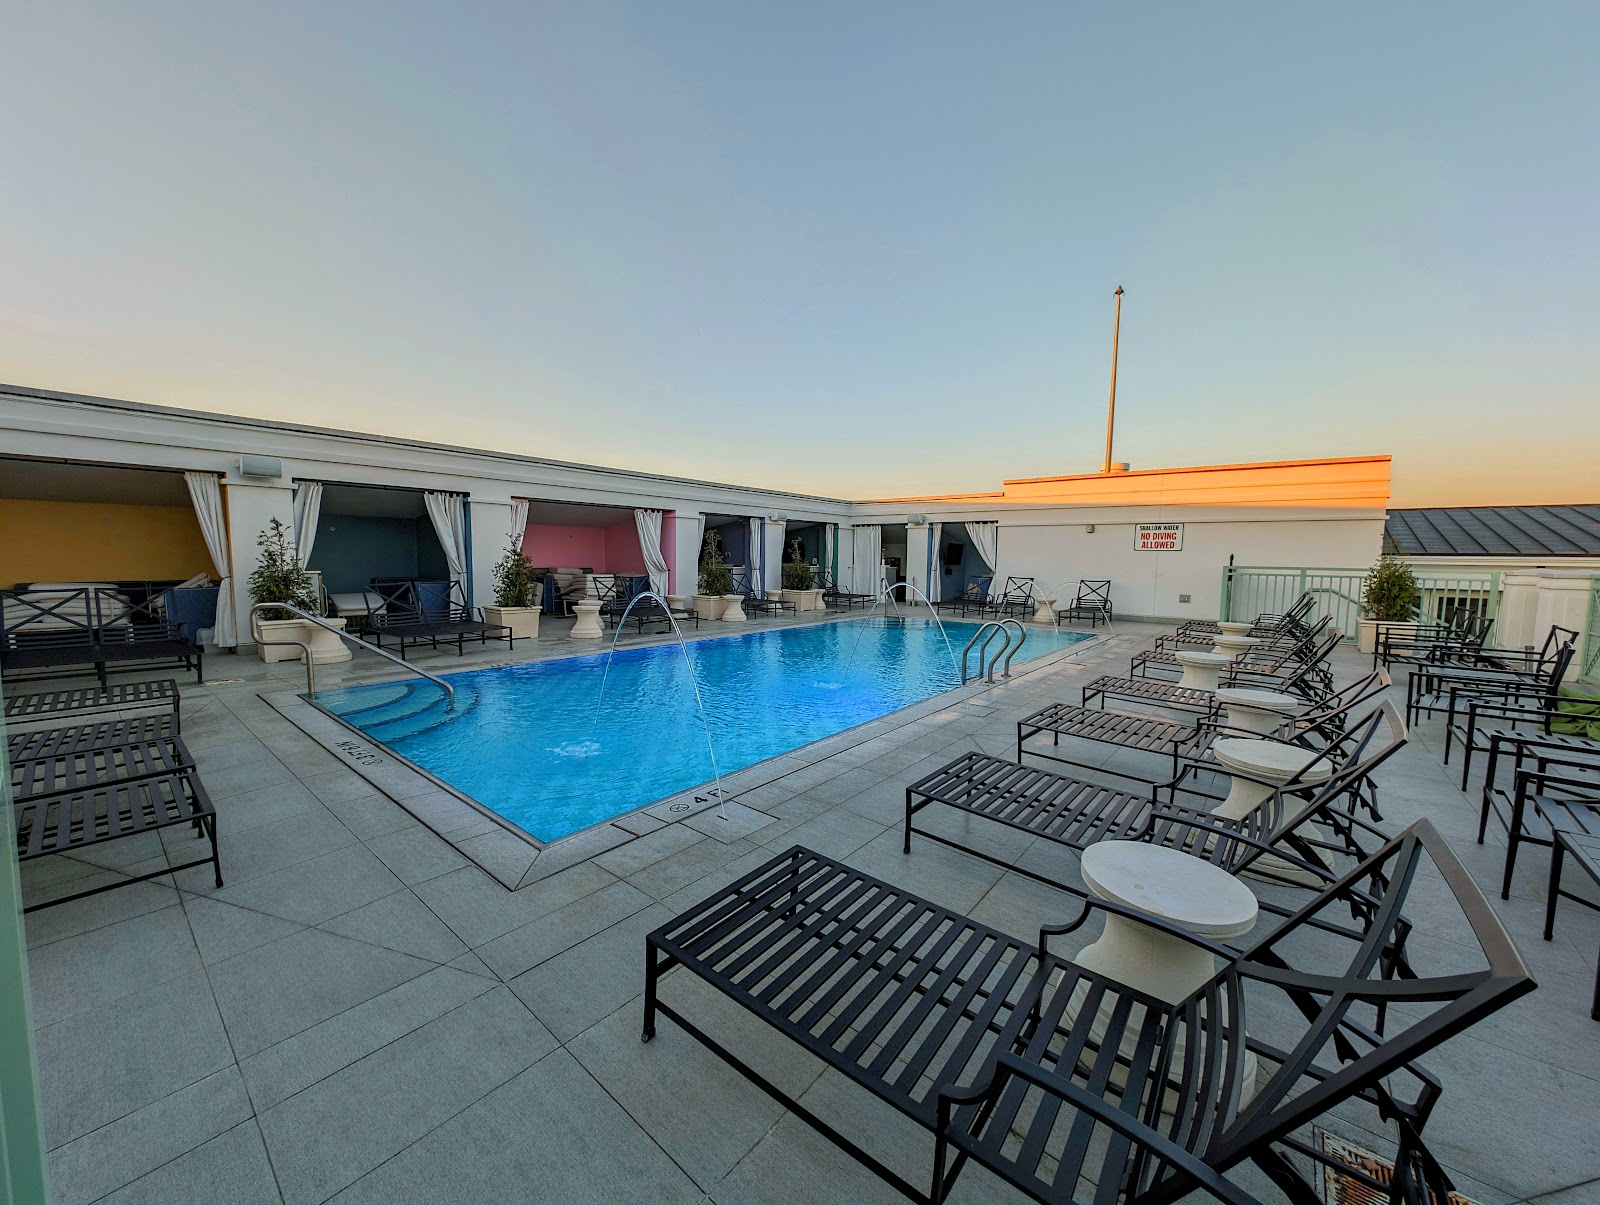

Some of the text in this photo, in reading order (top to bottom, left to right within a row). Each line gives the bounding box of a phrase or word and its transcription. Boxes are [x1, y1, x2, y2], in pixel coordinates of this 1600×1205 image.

[1140, 532, 1177, 540] NO DIVING
[1141, 541, 1175, 549] ALLOWED
